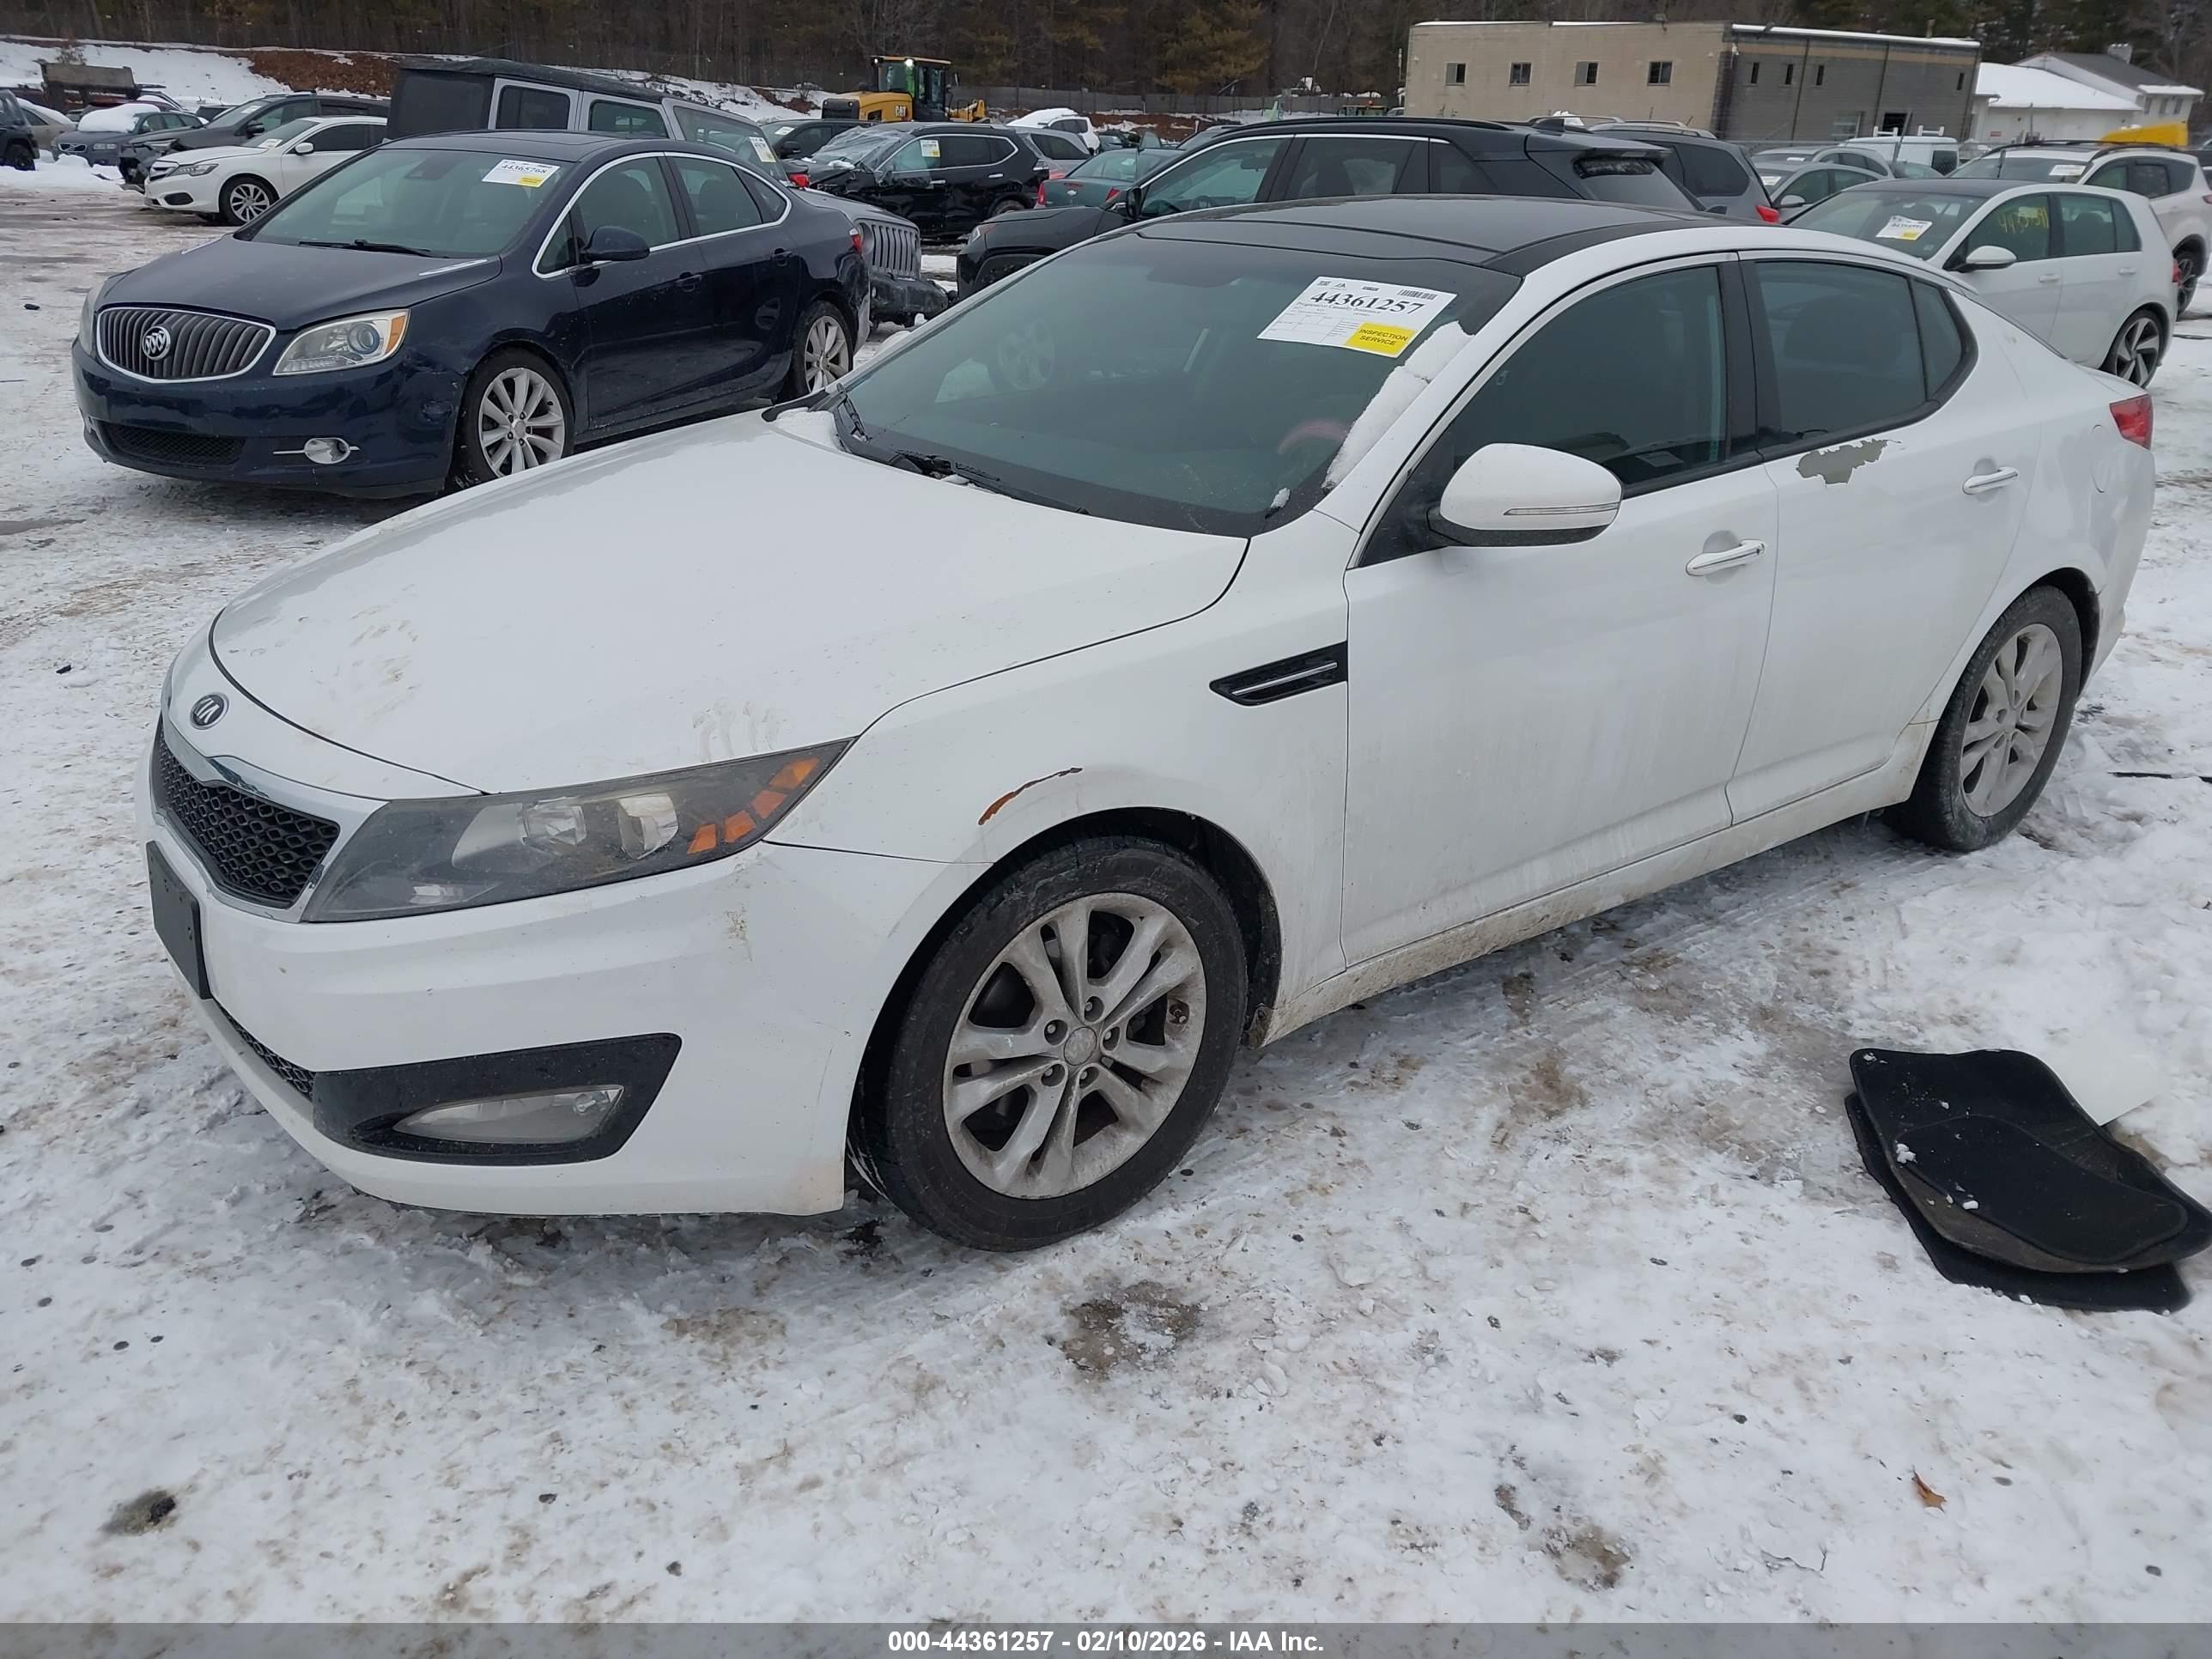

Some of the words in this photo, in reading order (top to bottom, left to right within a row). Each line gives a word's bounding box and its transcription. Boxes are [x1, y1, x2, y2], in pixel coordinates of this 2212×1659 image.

[895, 106, 907, 117] CAT
[1310, 291, 1425, 315] 44361257
[1358, 329, 1408, 342] INSPECTION
[1359, 335, 1397, 346] SERVICE
